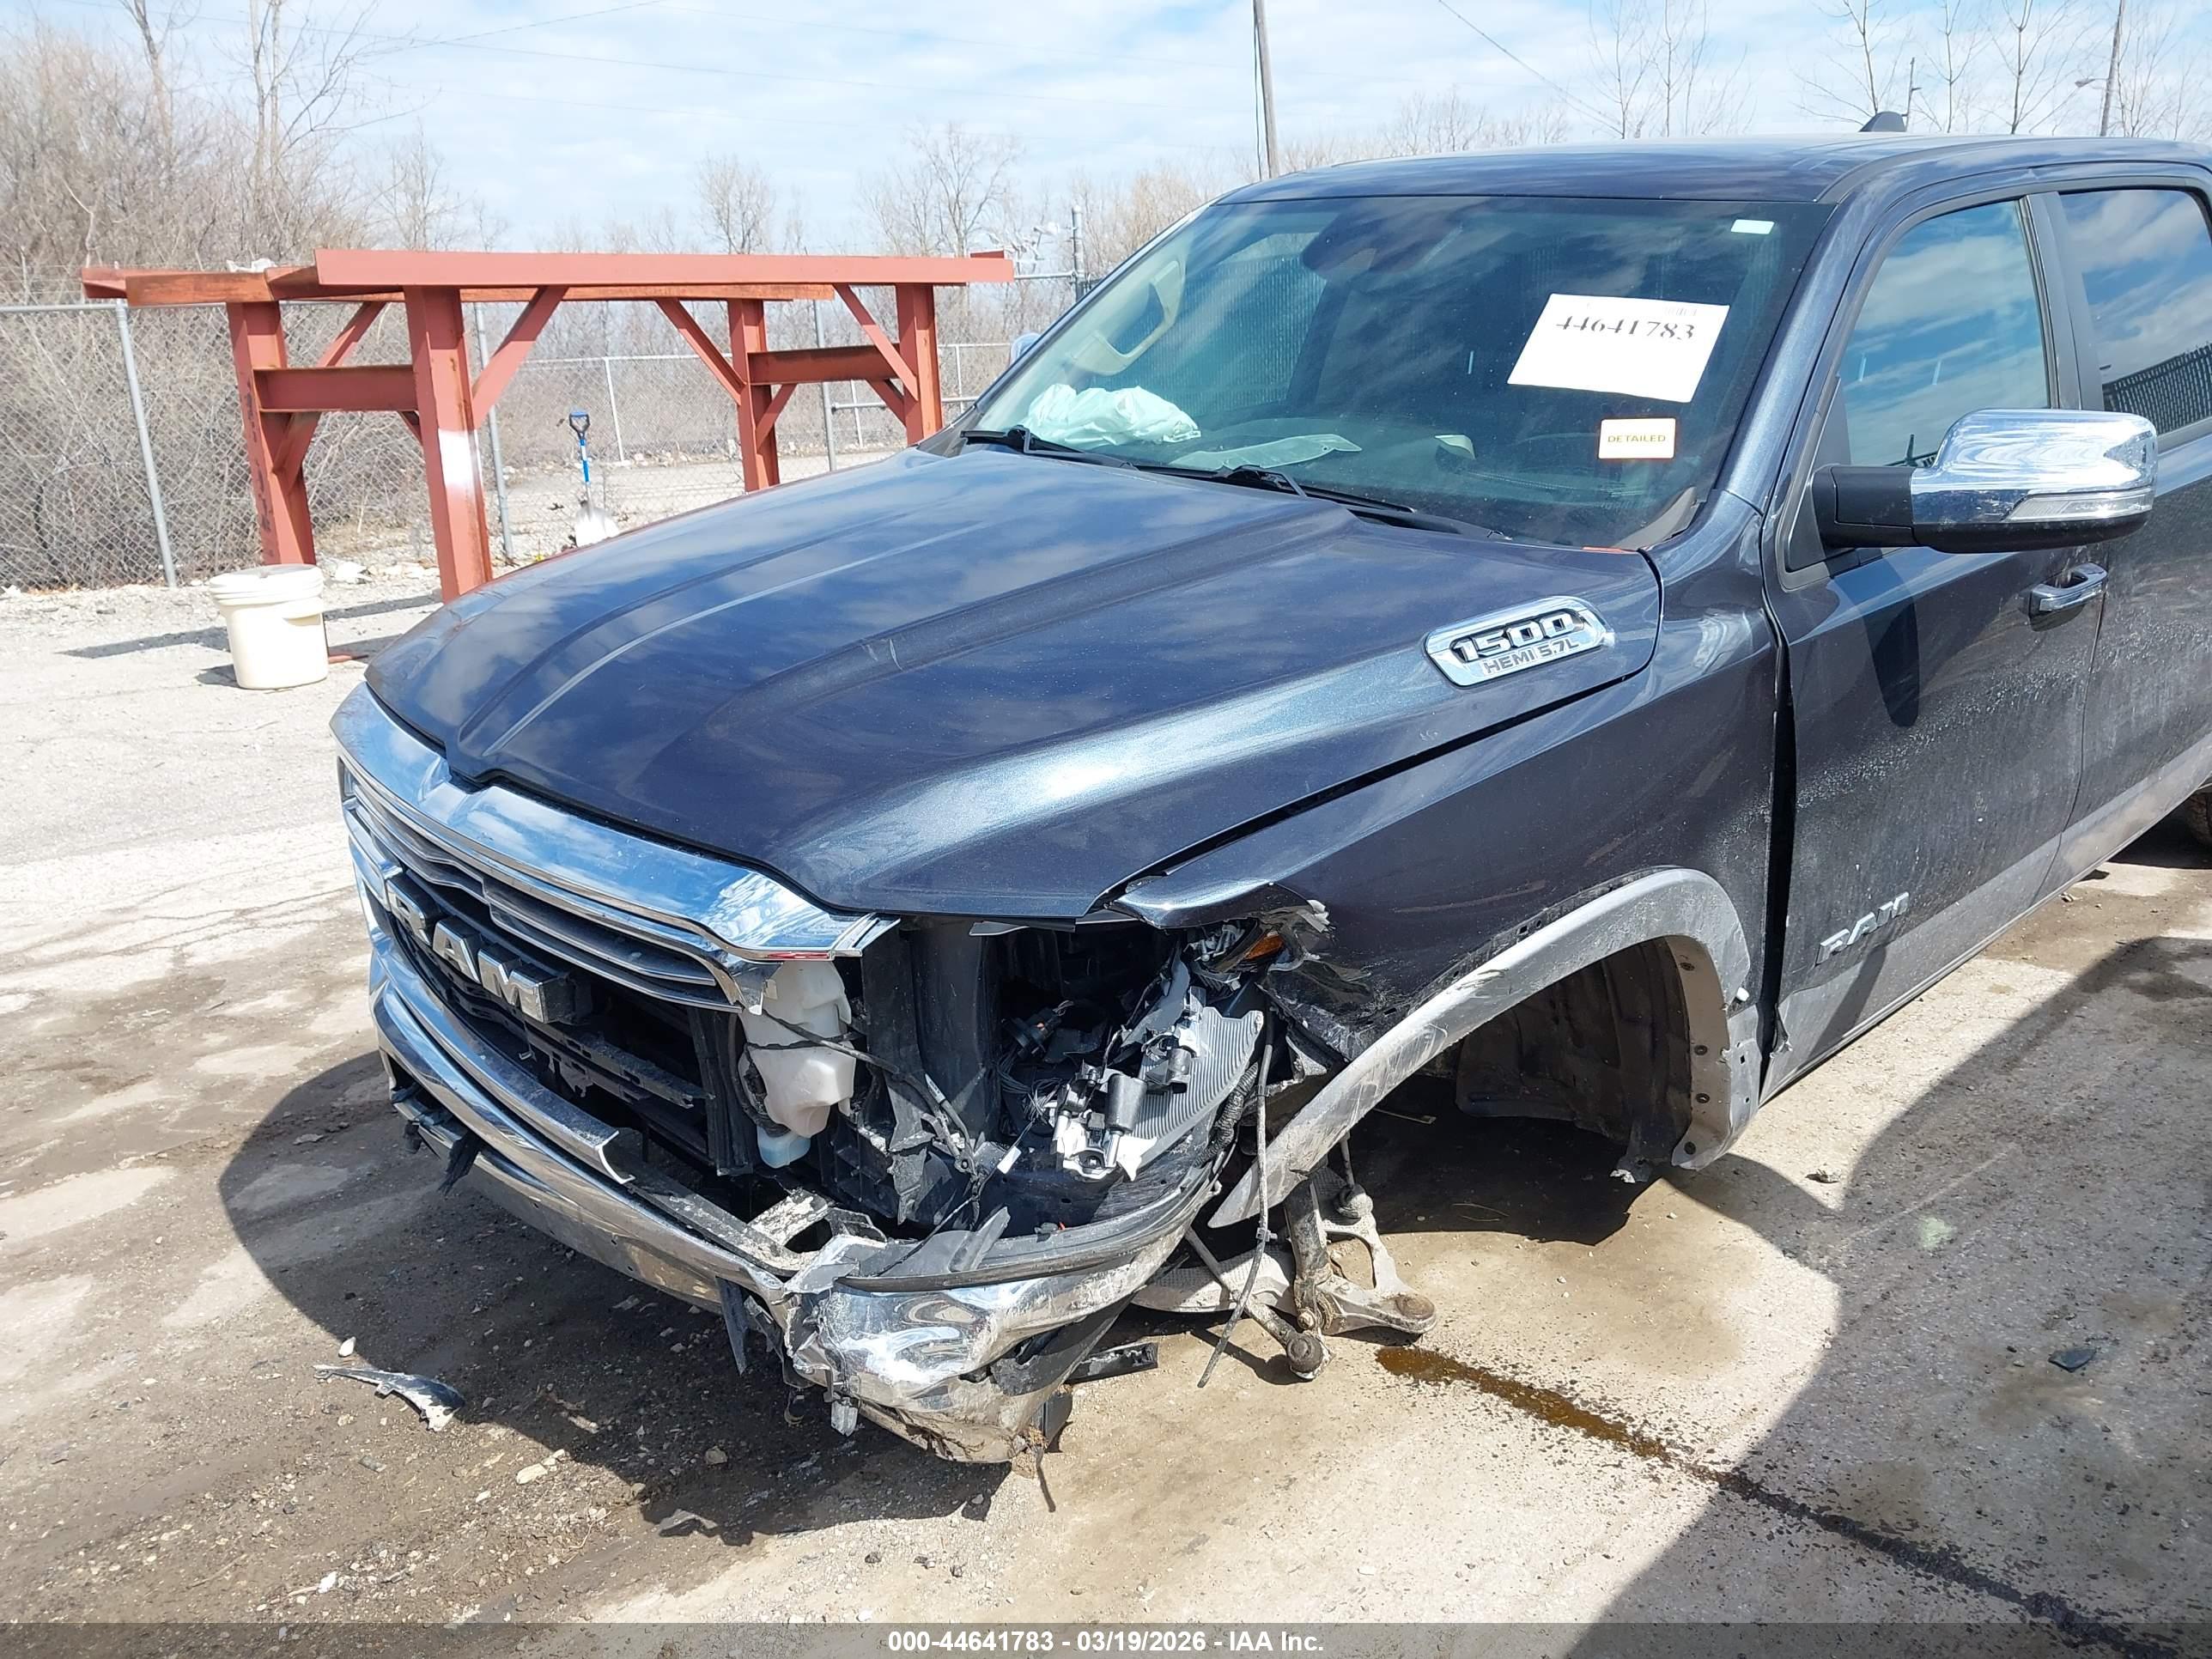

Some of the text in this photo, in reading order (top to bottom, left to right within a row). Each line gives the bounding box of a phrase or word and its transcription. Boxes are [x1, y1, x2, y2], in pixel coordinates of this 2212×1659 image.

[1556, 315, 1695, 340] 44641783
[1607, 434, 1666, 443] DETAILED
[1454, 613, 1577, 662] 1500
[1485, 638, 1580, 674] HEMI 5.7L
[386, 878, 546, 1024] RAM
